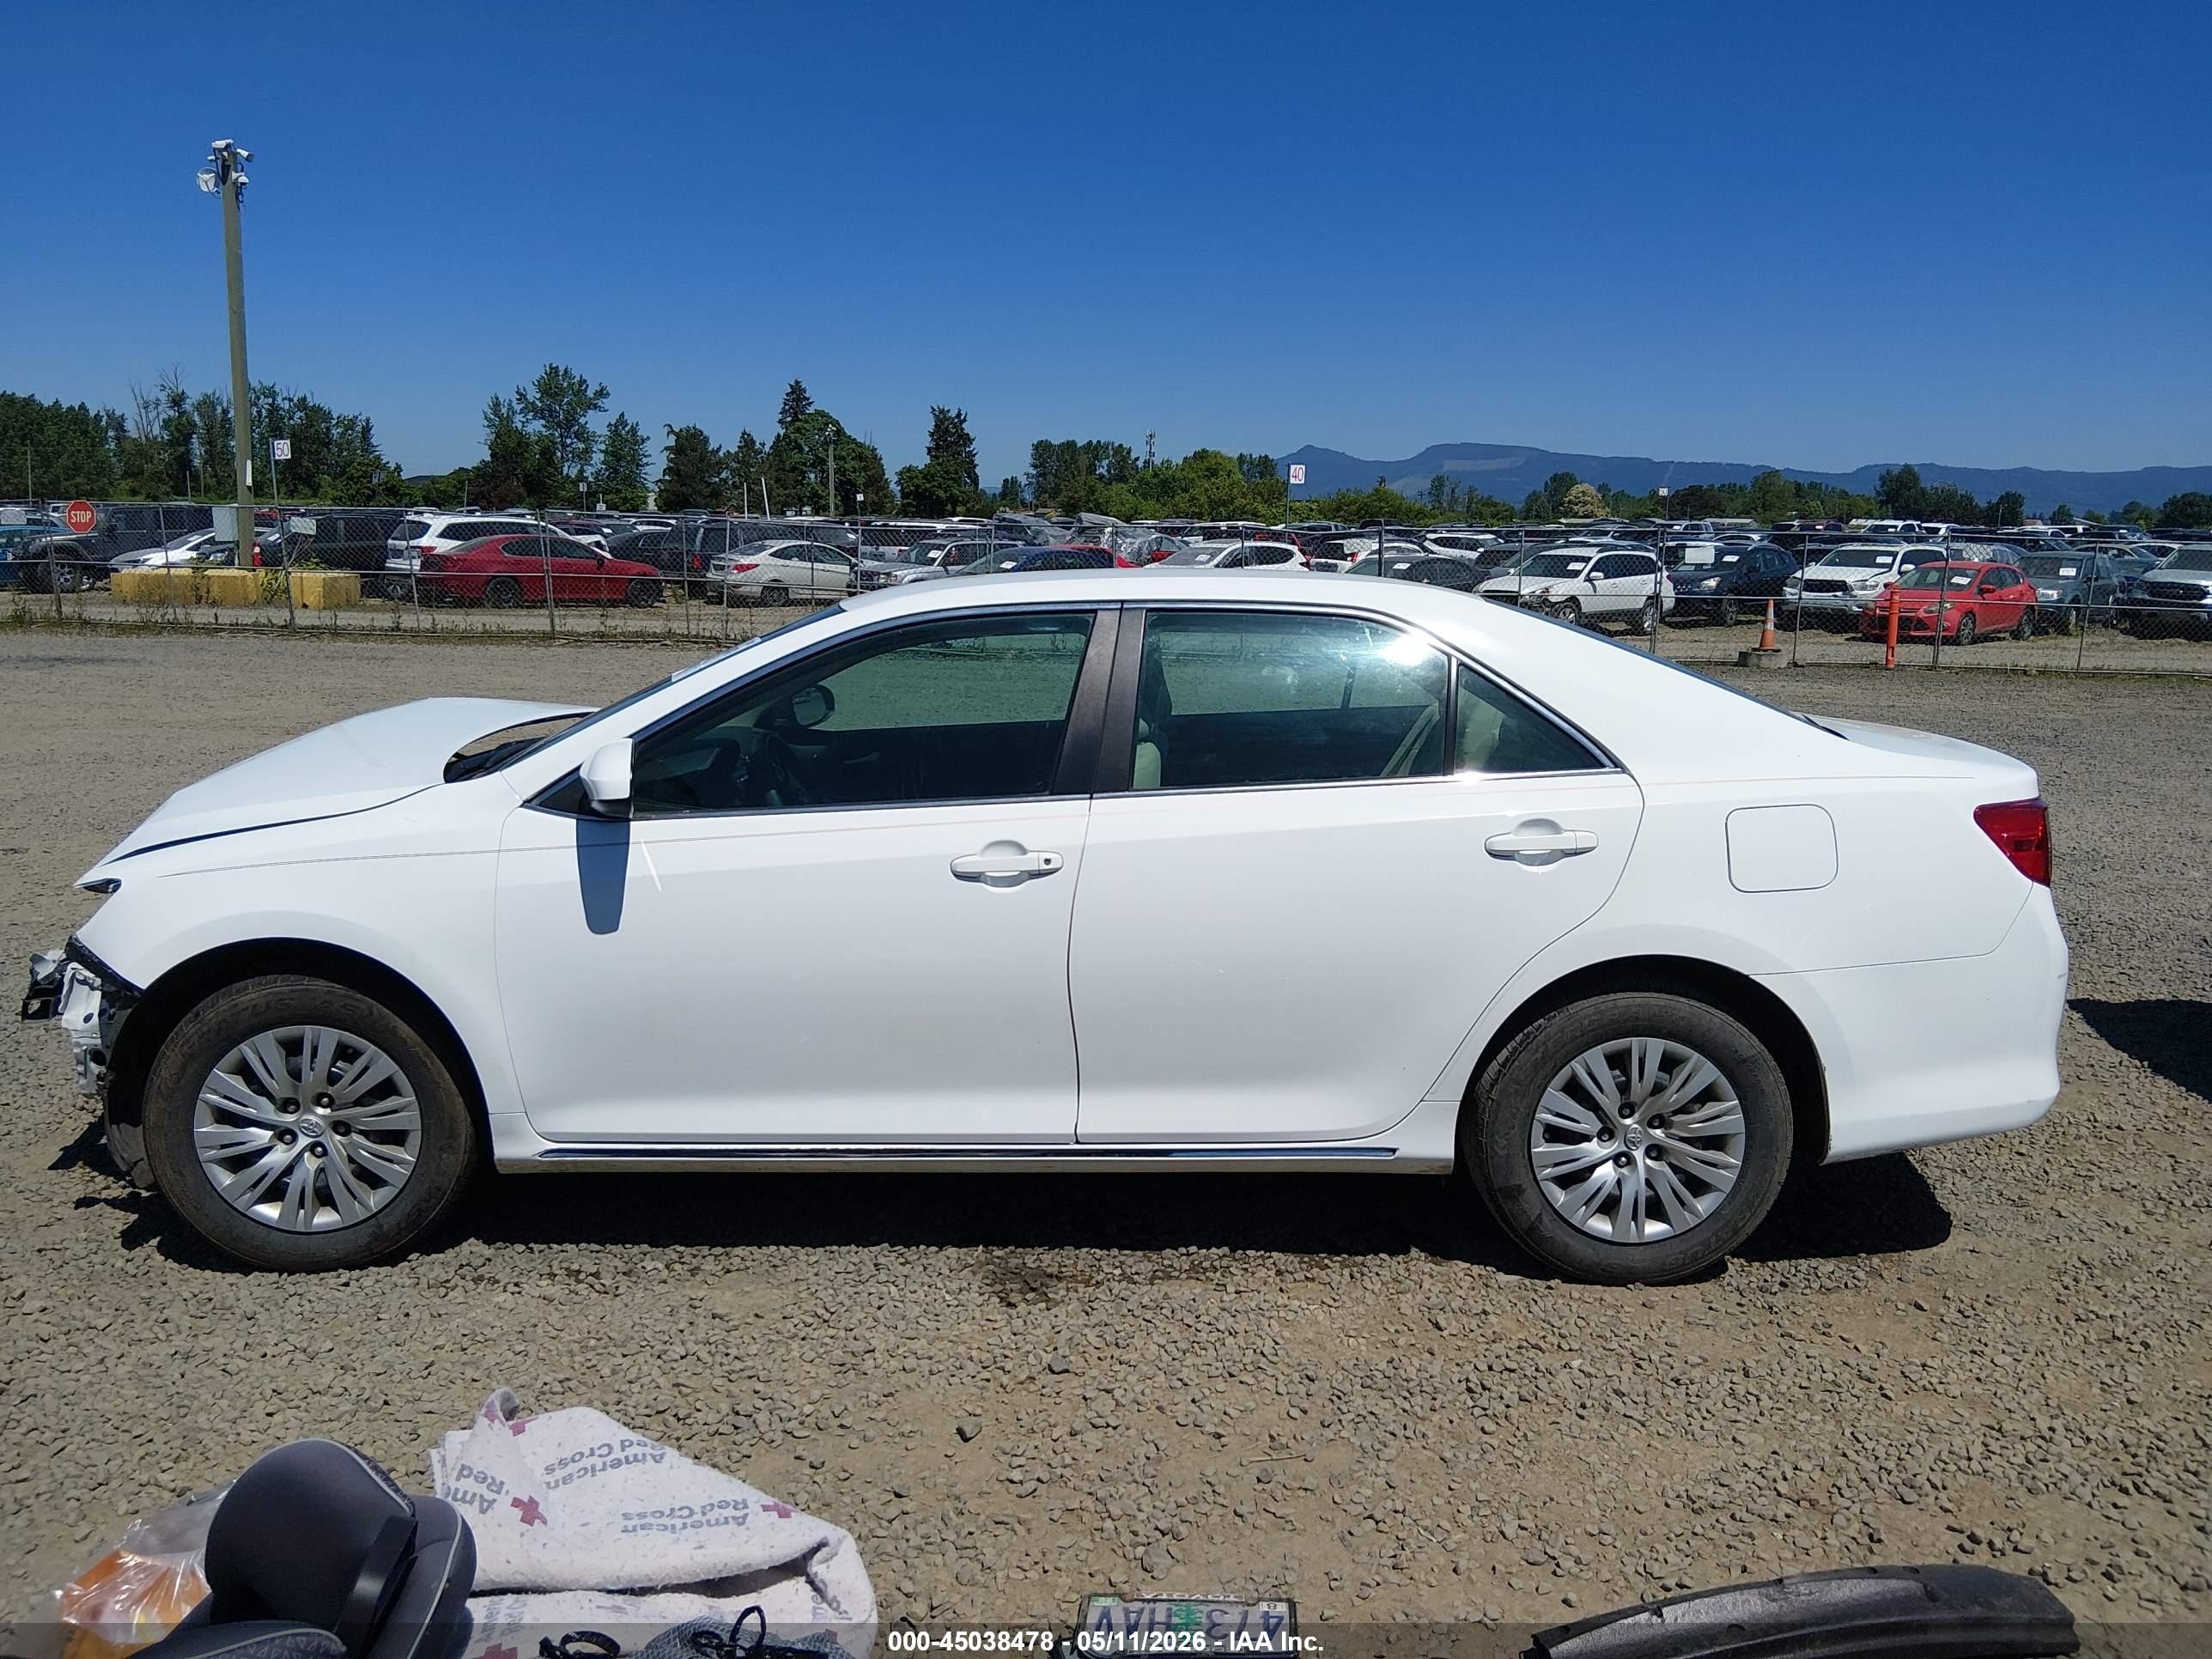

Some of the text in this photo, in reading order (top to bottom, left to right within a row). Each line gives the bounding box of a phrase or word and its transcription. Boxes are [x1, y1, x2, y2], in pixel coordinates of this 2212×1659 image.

[276, 441, 289, 457] 50
[1291, 466, 1304, 482] 40
[70, 510, 92, 523] STOP
[544, 1441, 614, 1476] Cross
[455, 1463, 505, 1496] Red
[543, 1451, 667, 1490] American
[621, 1498, 750, 1523] Red Cross
[620, 1512, 750, 1534] American
